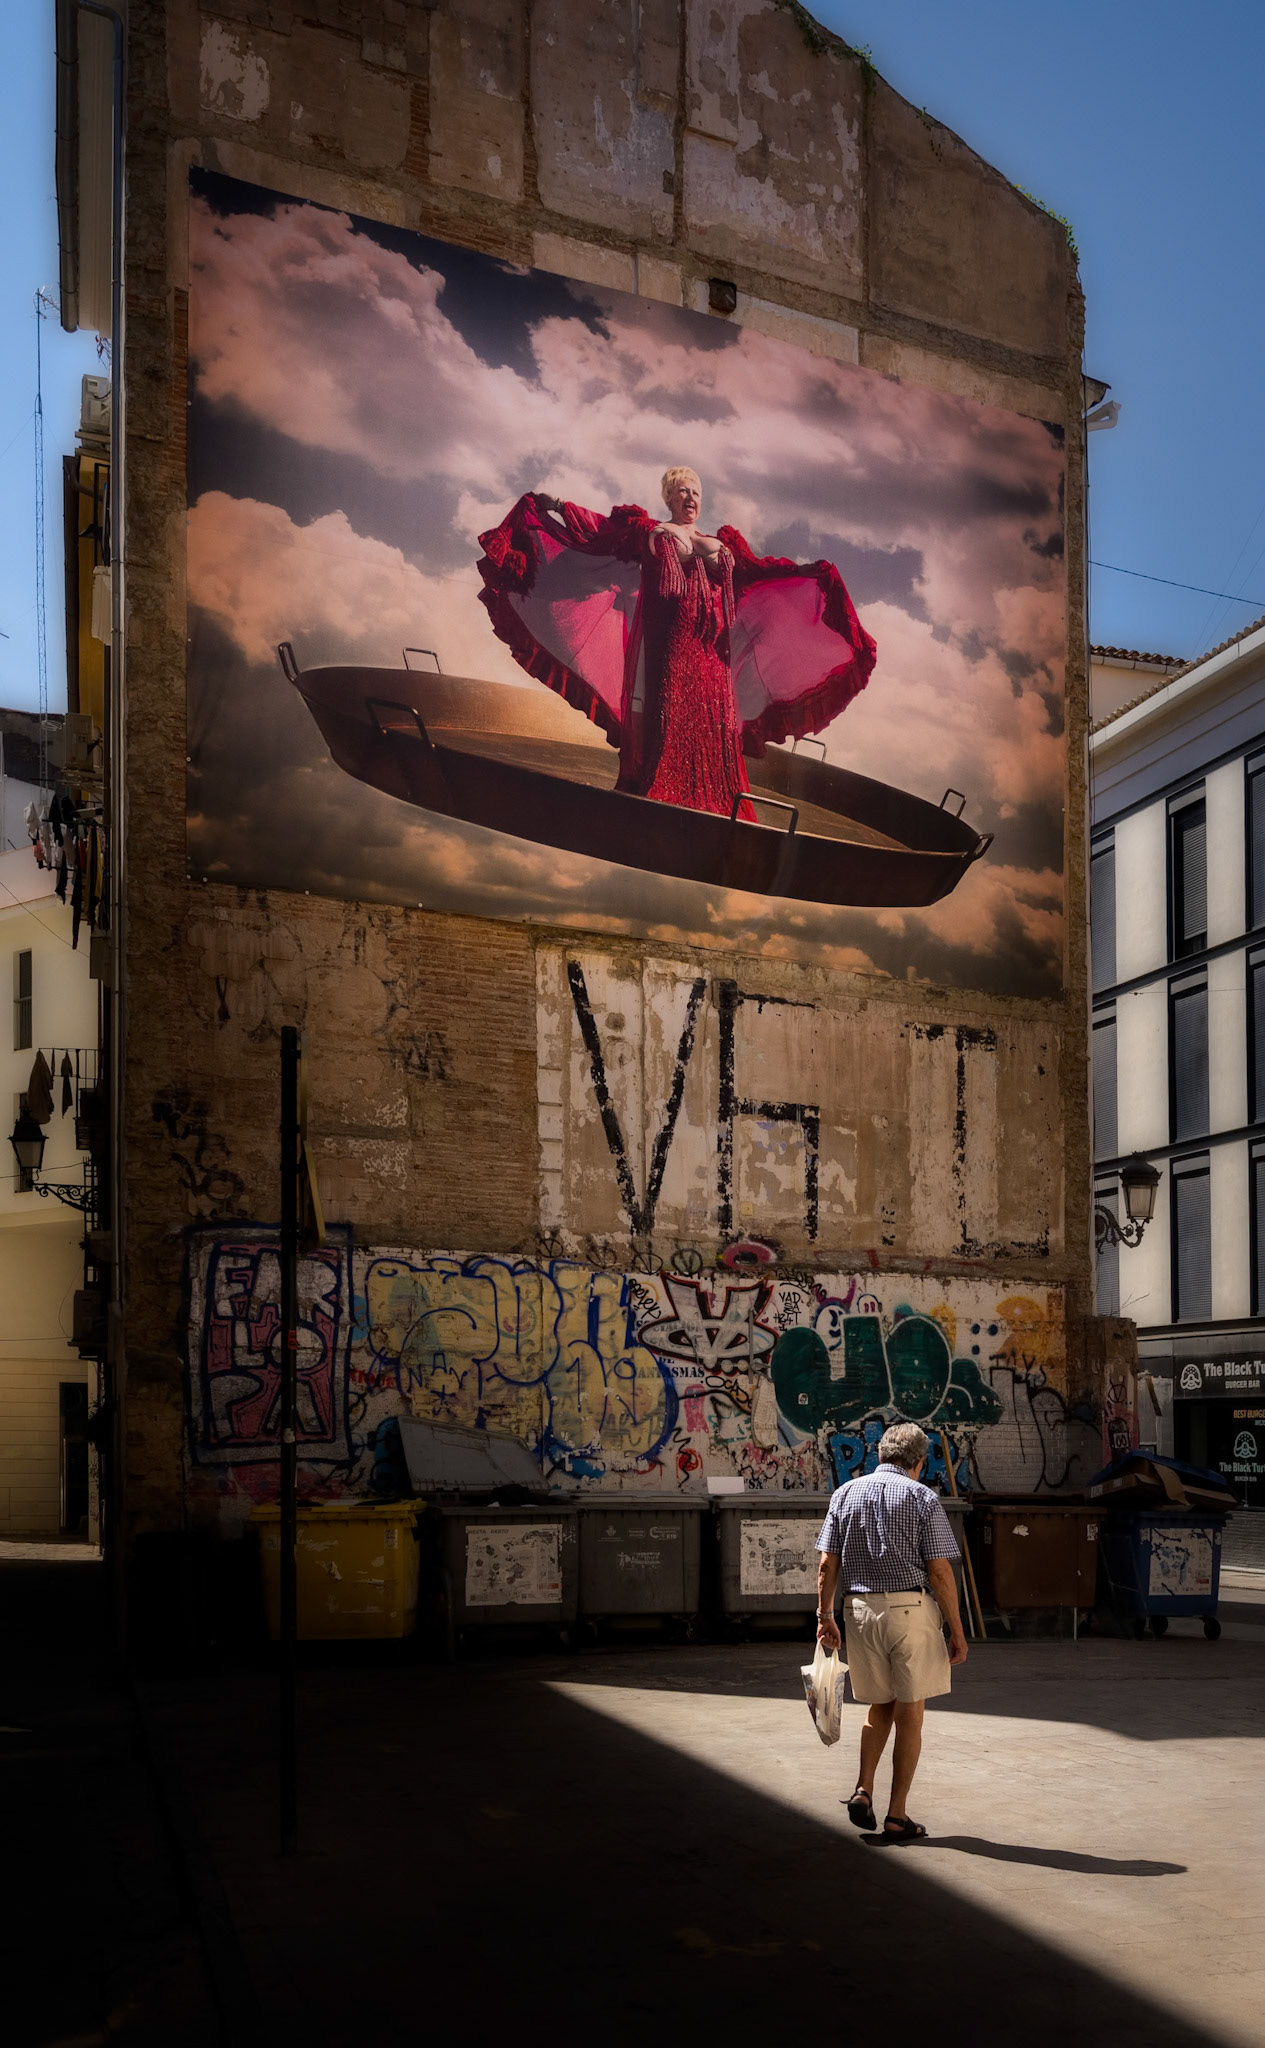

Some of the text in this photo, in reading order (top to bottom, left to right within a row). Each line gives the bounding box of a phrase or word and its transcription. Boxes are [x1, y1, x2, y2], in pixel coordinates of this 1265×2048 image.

[1203, 1363, 1223, 1377] The
[1224, 1361, 1253, 1376] Black
[1225, 1379, 1261, 1389] BURGER BAR
[1233, 1409, 1247, 1419] BEST
[1219, 1462, 1233, 1473] The
[1232, 1462, 1251, 1473] Black
